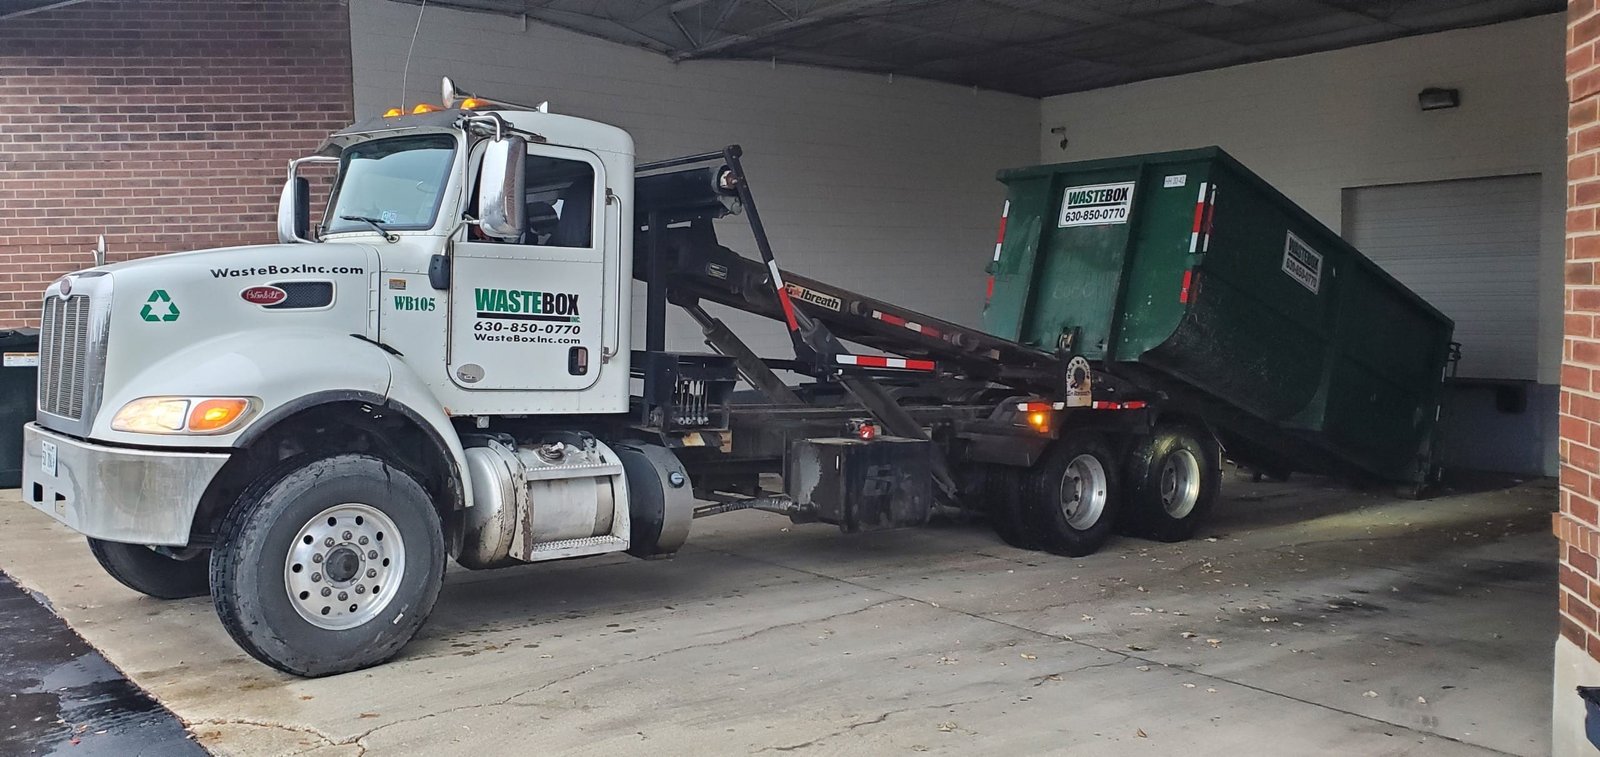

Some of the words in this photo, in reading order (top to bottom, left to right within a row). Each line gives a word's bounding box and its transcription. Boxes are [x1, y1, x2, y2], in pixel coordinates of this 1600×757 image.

[1068, 187, 1129, 205] WASTEBOX
[1065, 208, 1126, 222] 630-850-0770
[210, 264, 364, 278] WasteBoxInc.com
[246, 289, 281, 300] Peterbilt
[394, 295, 436, 312] WB105
[475, 288, 580, 316] WASTEBOX
[474, 321, 581, 335] 630-850-0770
[474, 333, 581, 344] WasteBoxInc.com
